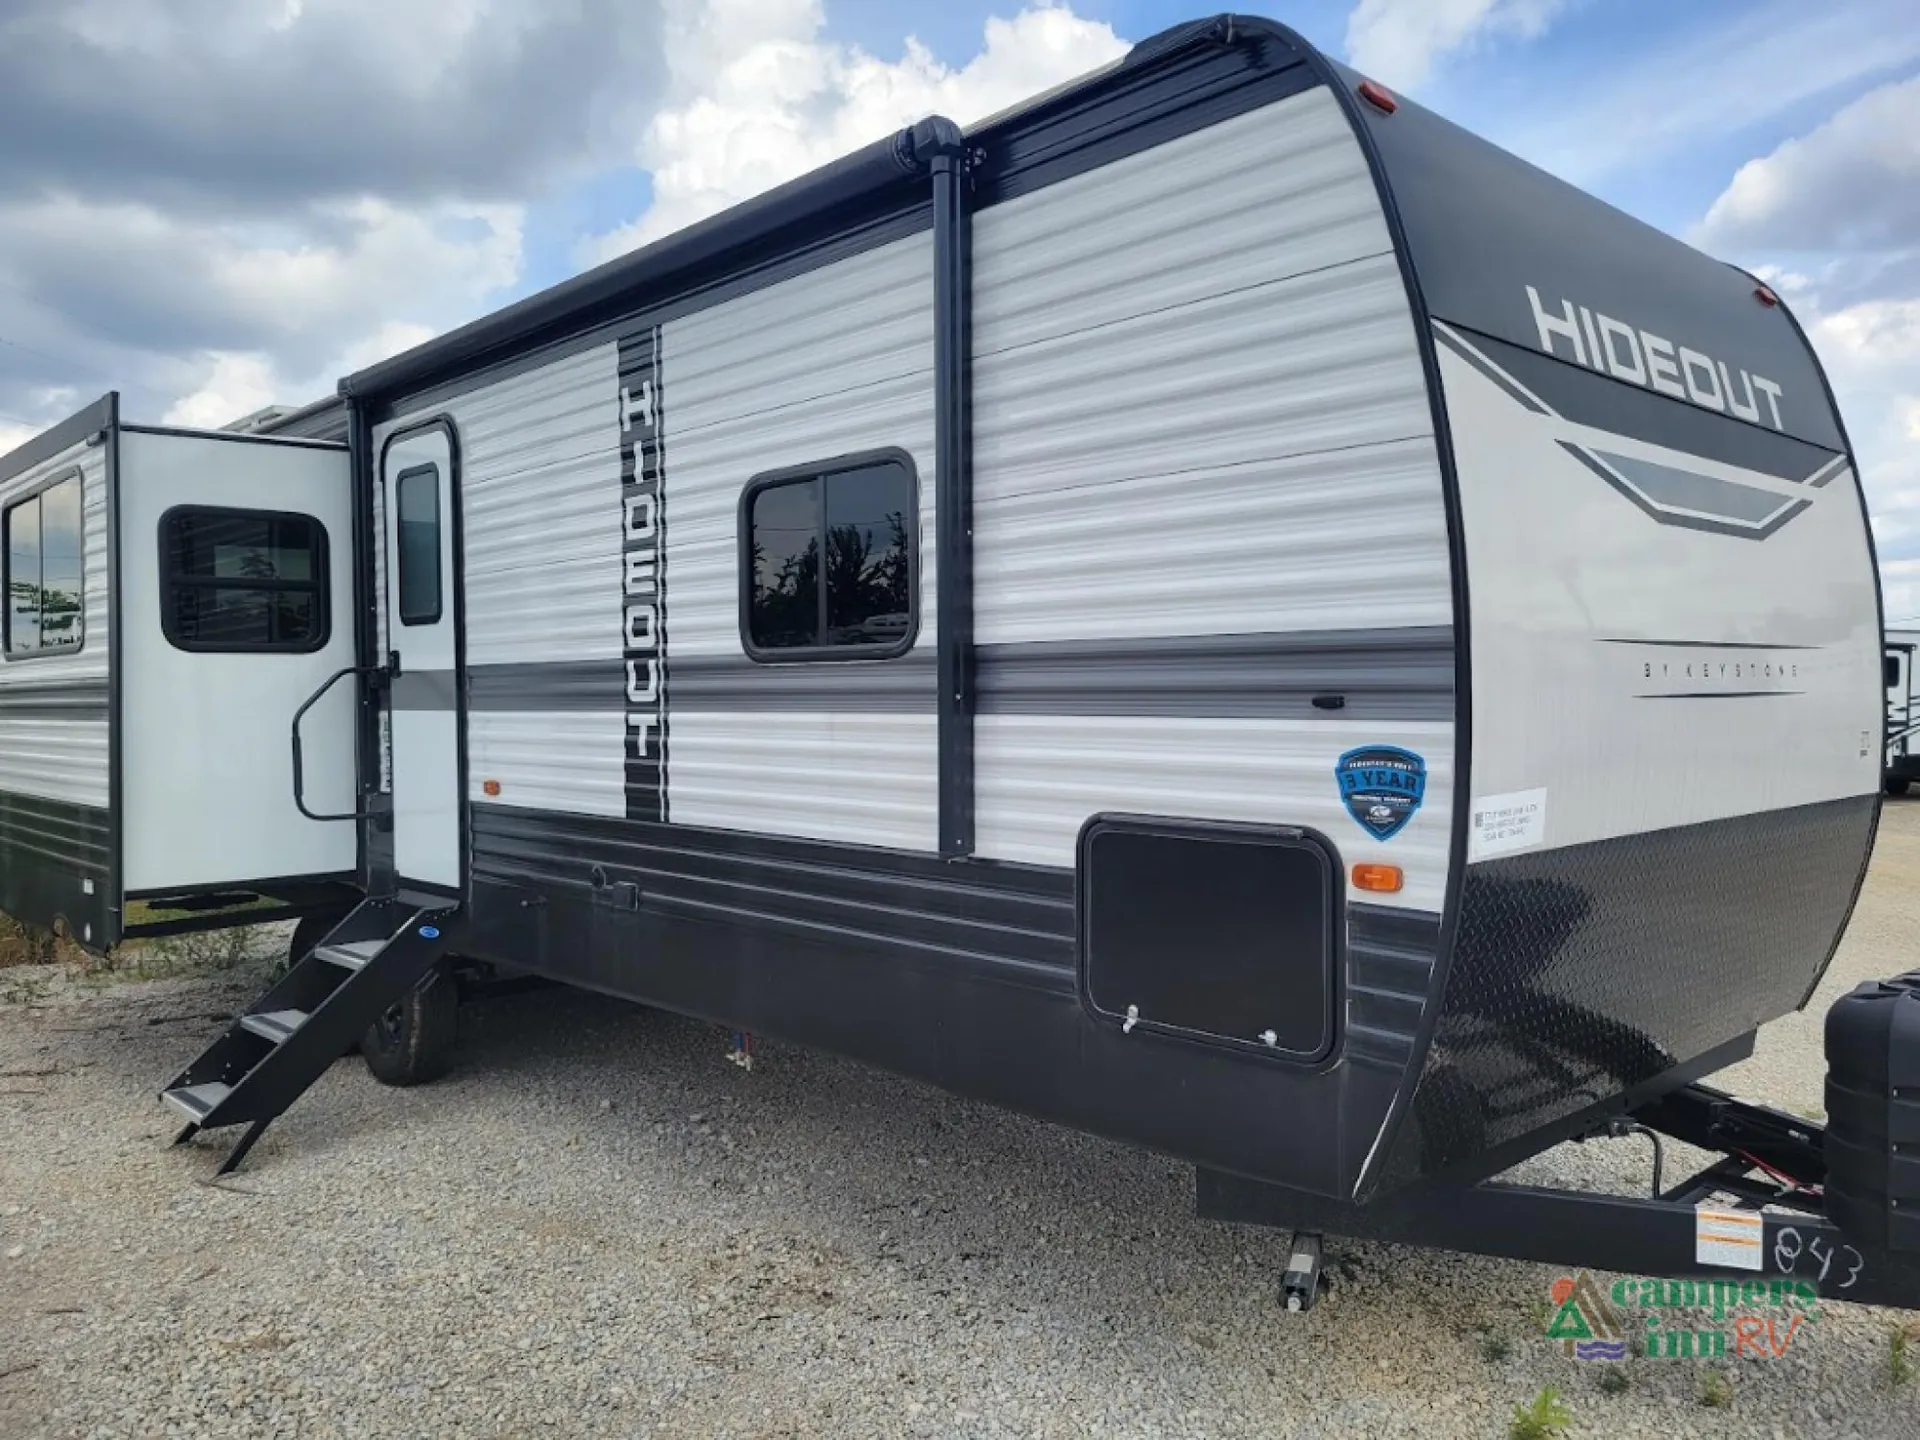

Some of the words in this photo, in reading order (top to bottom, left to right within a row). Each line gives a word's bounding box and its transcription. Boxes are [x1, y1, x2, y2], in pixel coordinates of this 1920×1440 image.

[1525, 284, 1783, 430] HIDEOUT
[622, 380, 657, 756] HIDEOUT
[1644, 662, 1668, 678] BY
[1686, 662, 1797, 679] KEYSTONE
[1345, 772, 1356, 789] 3
[1362, 770, 1417, 792] YEAR
